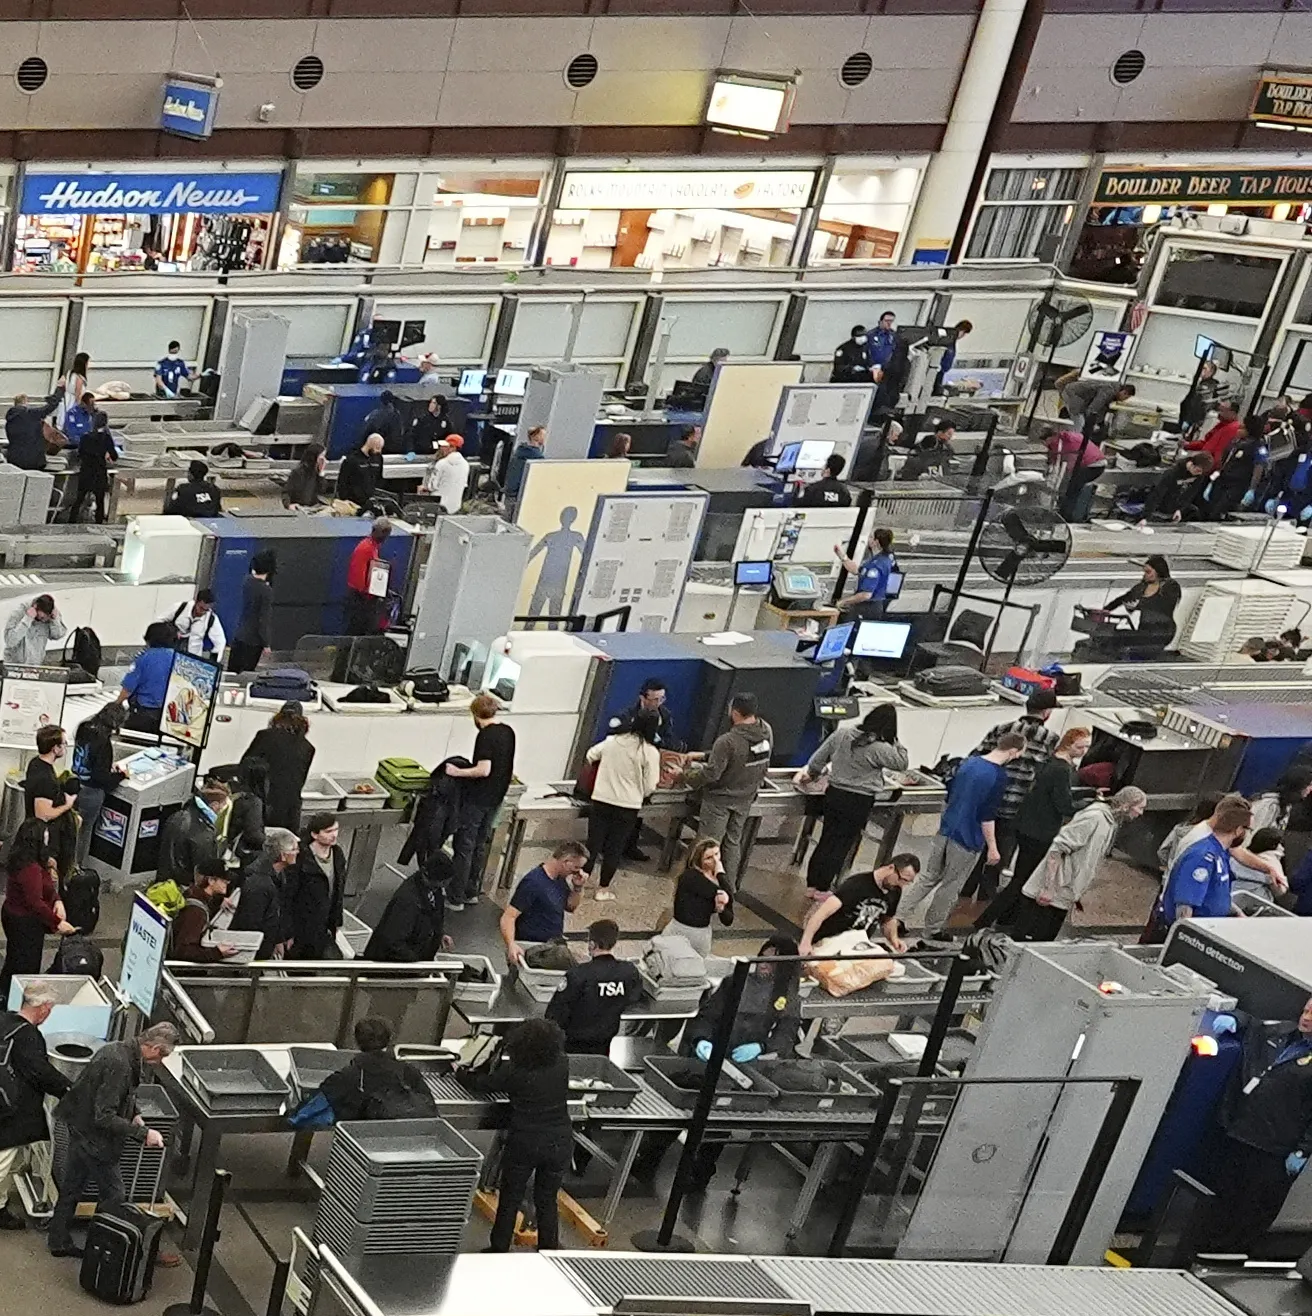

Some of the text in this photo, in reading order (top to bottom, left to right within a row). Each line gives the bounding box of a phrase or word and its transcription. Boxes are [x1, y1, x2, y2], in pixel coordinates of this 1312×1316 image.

[39, 181, 259, 209] Hudson News
[1105, 177, 1183, 195] BOULDER
[1187, 176, 1232, 195] BEER
[1239, 176, 1271, 194] TAP
[1177, 931, 1245, 973] smiths detection
[597, 981, 625, 997] TSA
